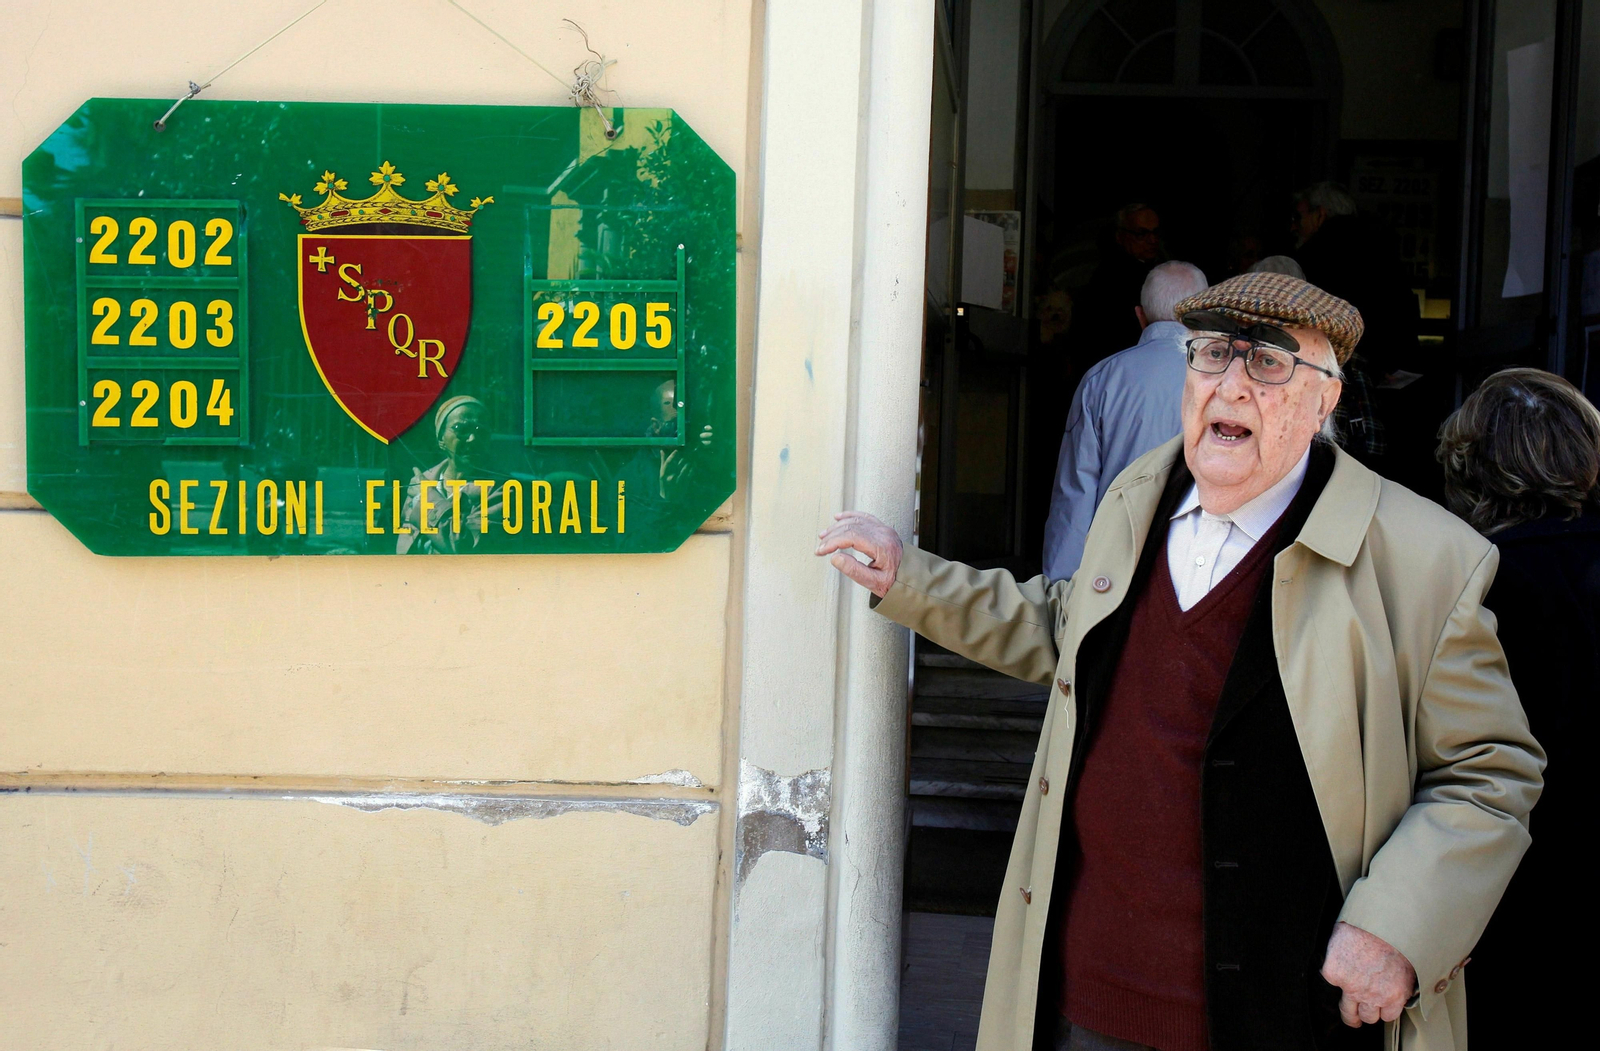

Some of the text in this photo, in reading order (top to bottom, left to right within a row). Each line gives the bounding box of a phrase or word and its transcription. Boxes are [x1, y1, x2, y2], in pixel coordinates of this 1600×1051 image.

[1393, 178, 1430, 195] 2202
[89, 216, 234, 269] 2202
[91, 297, 235, 349] 2203
[337, 263, 449, 378] SPQR
[536, 301, 672, 350] 2205
[92, 379, 234, 429] 2204
[149, 479, 626, 535] SEZIONI ELETTORALI
